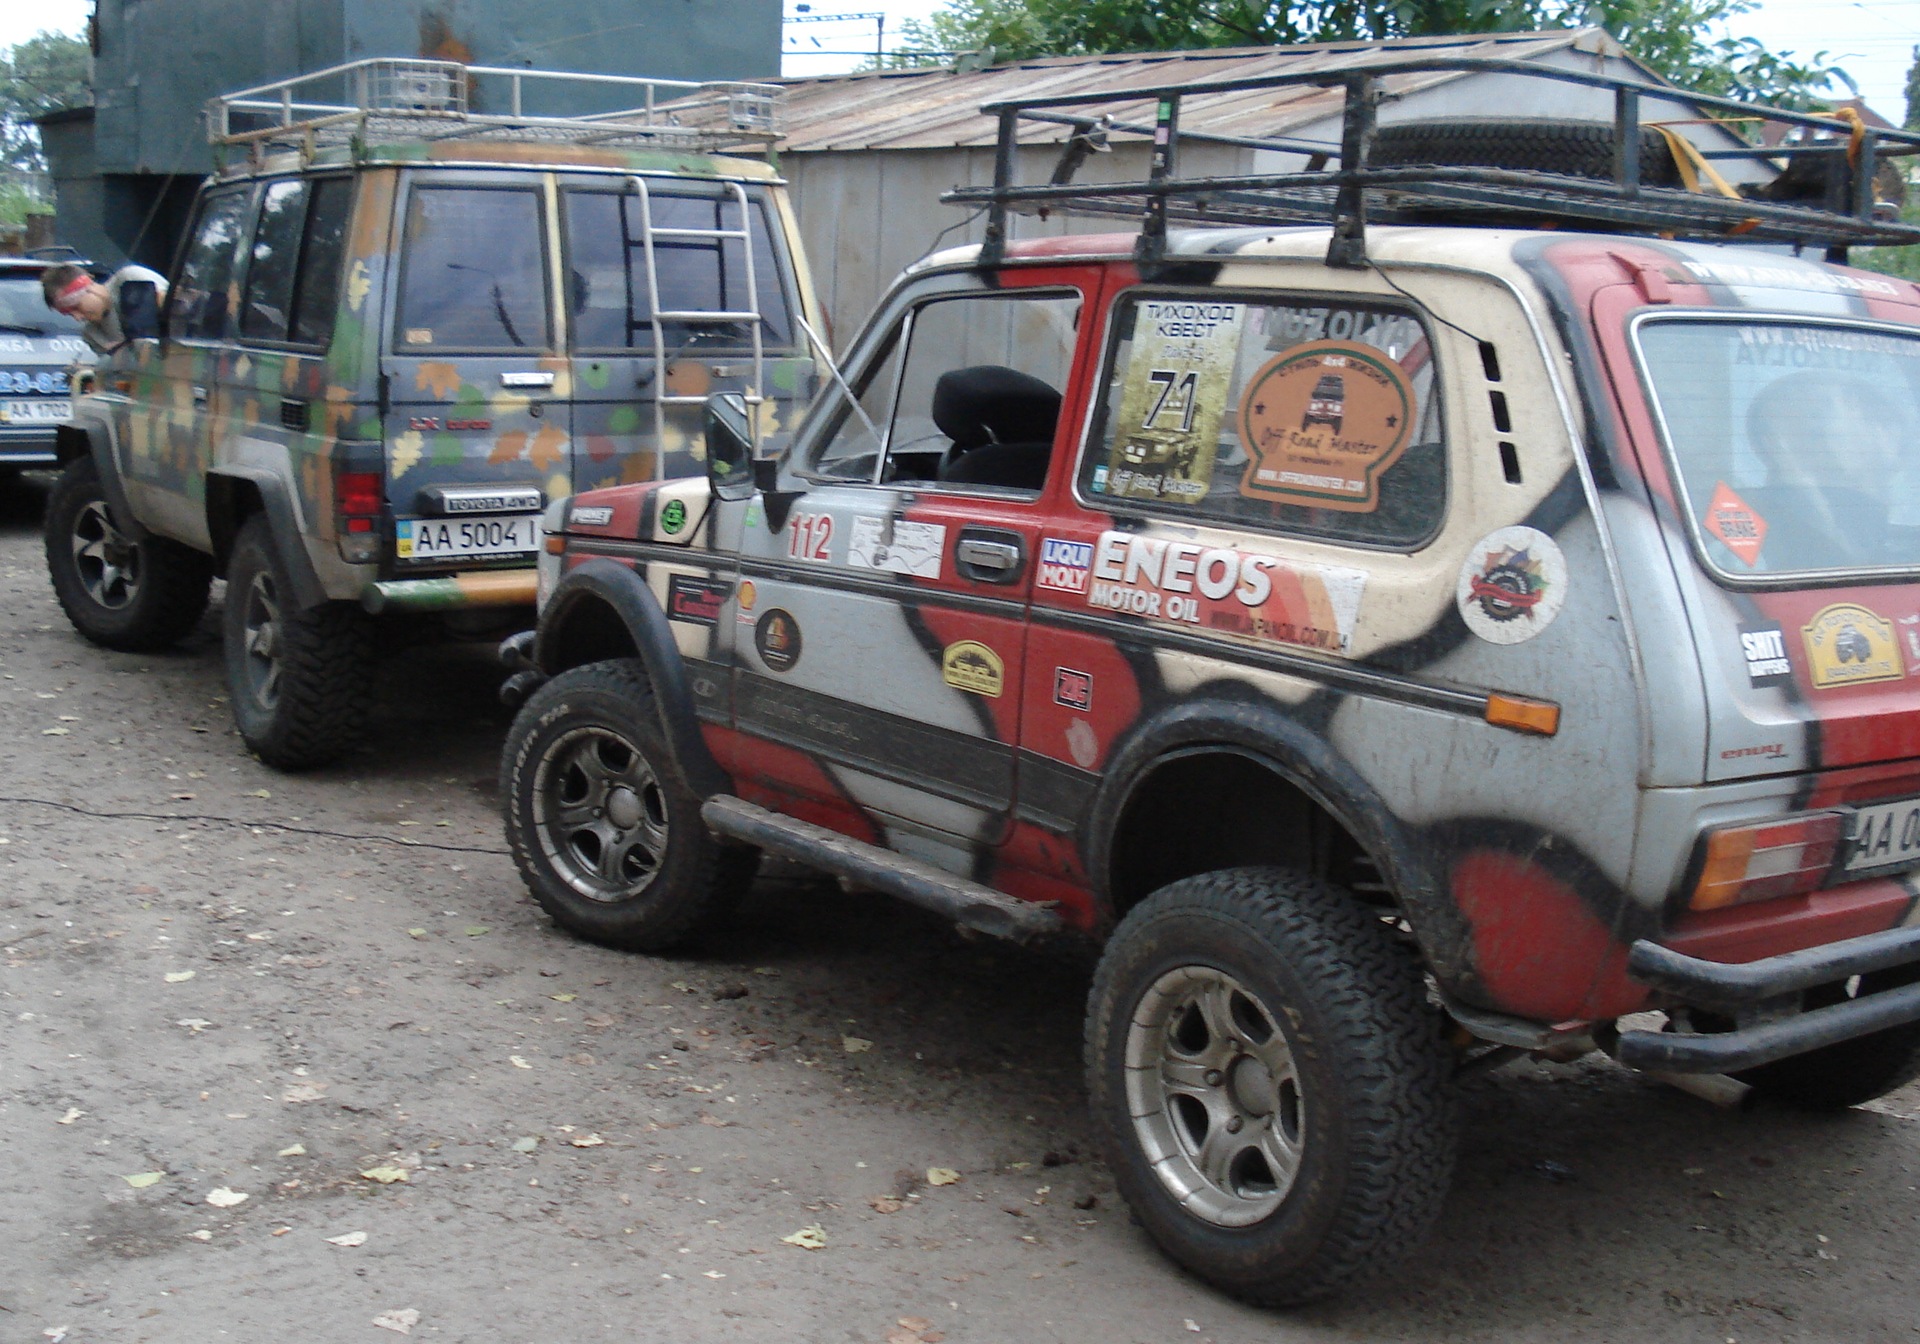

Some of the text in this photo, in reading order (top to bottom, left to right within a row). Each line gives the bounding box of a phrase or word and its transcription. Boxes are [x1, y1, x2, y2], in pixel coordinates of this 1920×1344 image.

[1147, 304, 1235, 322] ТИХОХОД
[1156, 322, 1217, 338] КВЕСТ
[1142, 368, 1201, 432] 71
[450, 497, 540, 510] TOYOTA 4WD
[417, 524, 453, 551] AA
[459, 521, 518, 549] 5004
[788, 512, 835, 563] 112
[1043, 541, 1092, 568] LIQUI
[1093, 530, 1276, 607] ENEOS
[1040, 564, 1088, 590] MOLY
[1089, 582, 1200, 624] MOTOR OIL
[1741, 630, 1785, 661] SHIT
[1857, 807, 1920, 858] AA 0
